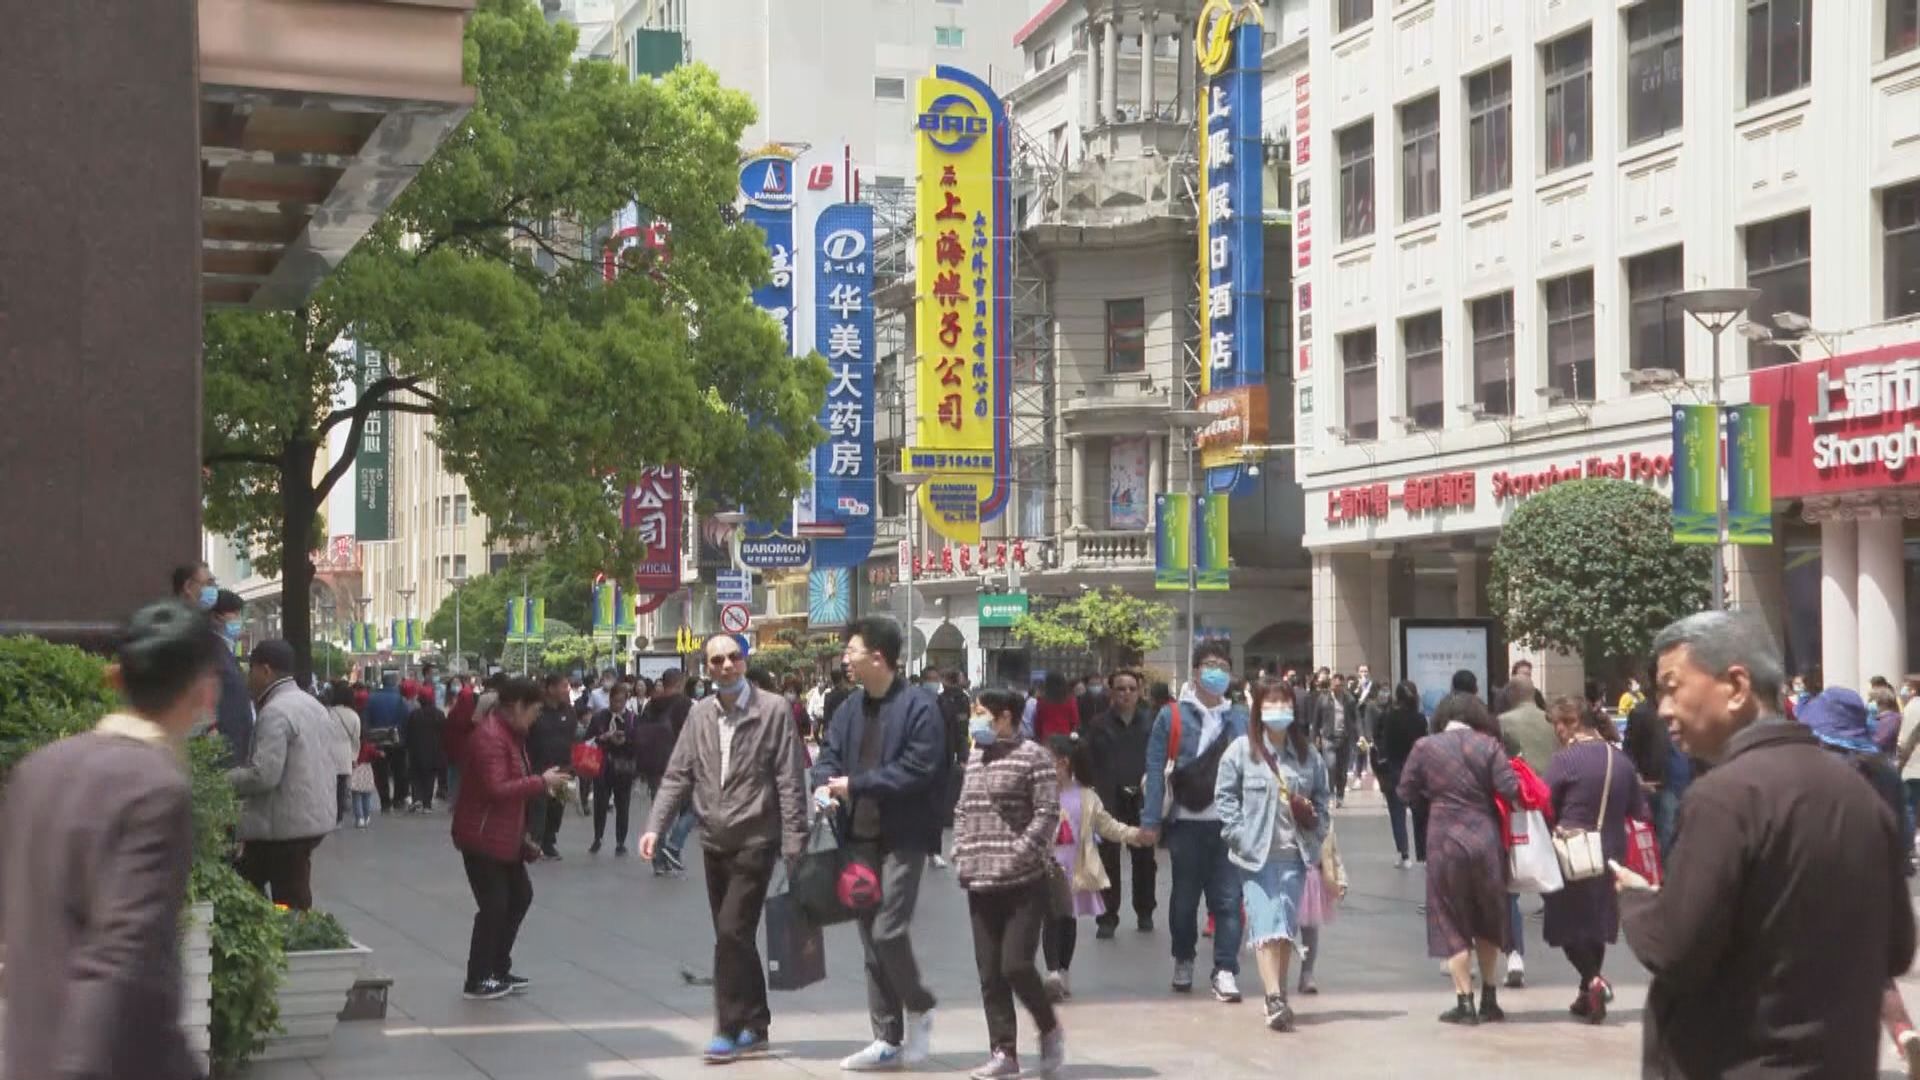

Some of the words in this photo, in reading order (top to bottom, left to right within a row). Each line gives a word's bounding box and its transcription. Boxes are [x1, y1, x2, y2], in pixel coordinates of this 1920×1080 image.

[918, 114, 987, 134] BAC
[1207, 86, 1234, 369] 上服假日酒店
[828, 283, 862, 475] 华美大药房
[743, 543, 806, 554] BAROMON
[631, 561, 673, 574] PTICAL
